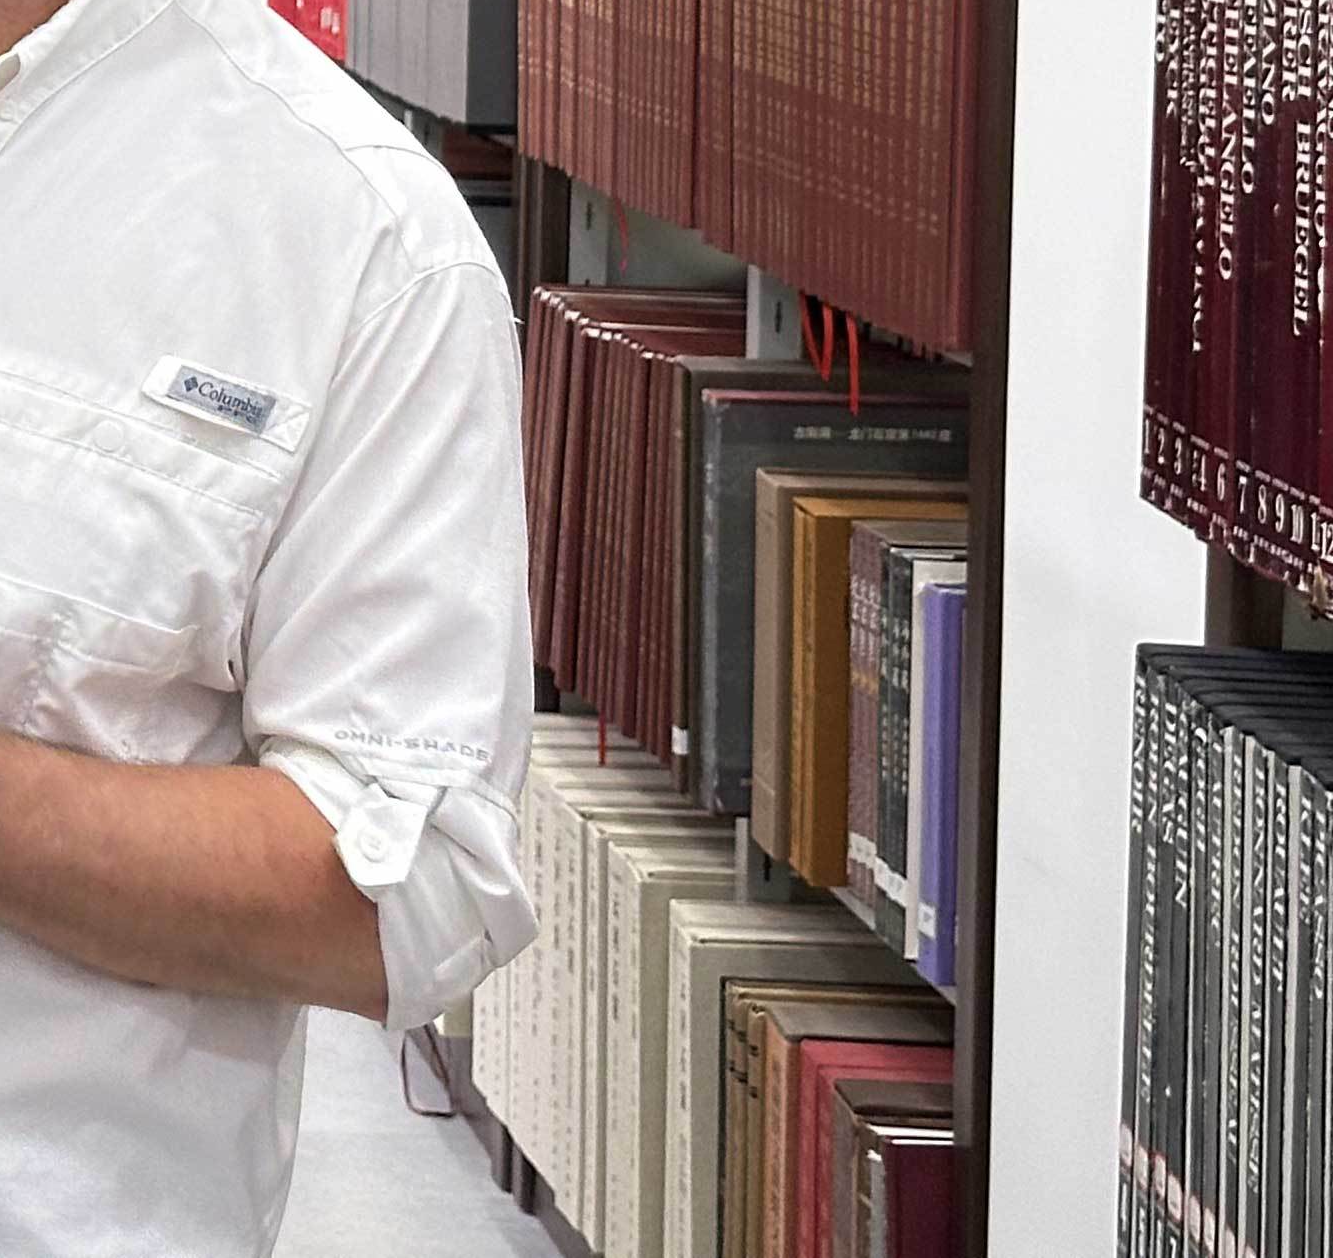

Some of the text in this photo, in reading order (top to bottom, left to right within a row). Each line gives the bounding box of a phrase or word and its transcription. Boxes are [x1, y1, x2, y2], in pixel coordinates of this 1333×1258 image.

[1166, 8, 1182, 118] EYCK
[1293, 121, 1312, 337] BRUEGEL
[198, 380, 263, 420] Columbia
[1173, 436, 1182, 476] 3
[1216, 462, 1226, 502] 6
[1238, 475, 1247, 514] 7
[1257, 483, 1268, 524] 8
[1274, 493, 1285, 534] 9
[1290, 504, 1304, 545] 10
[334, 729, 491, 762] OMNI-SHADE
